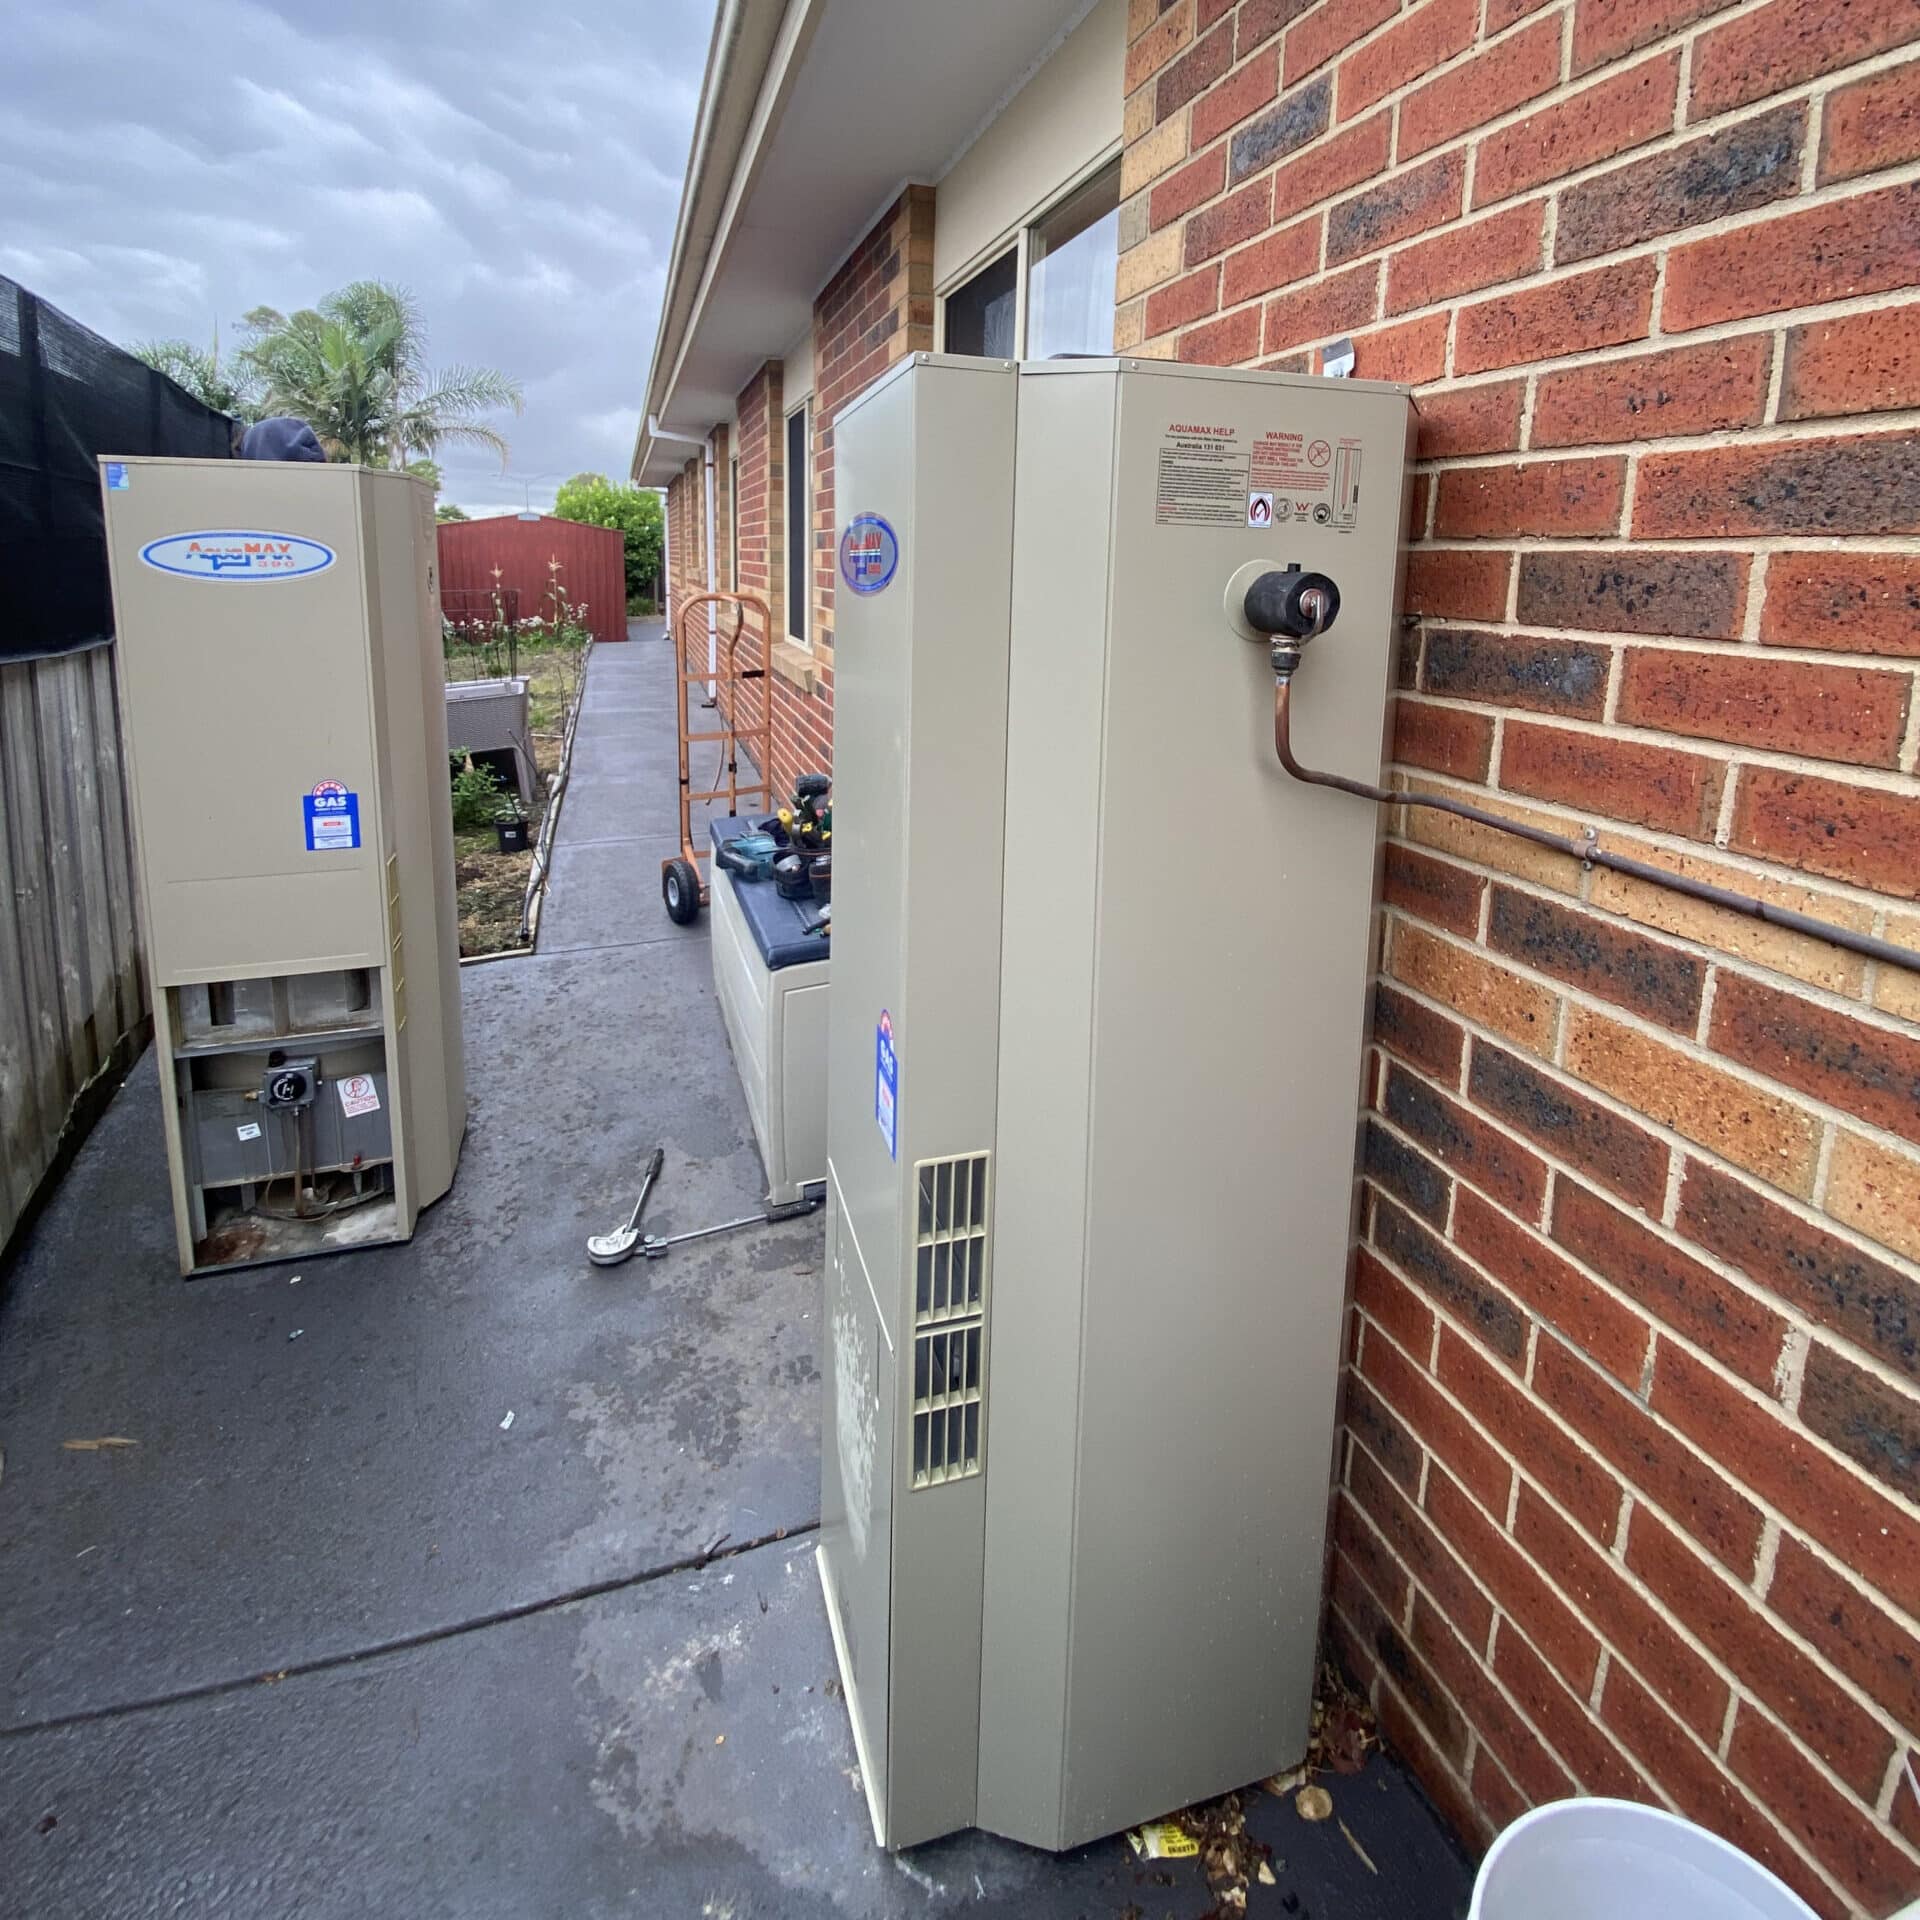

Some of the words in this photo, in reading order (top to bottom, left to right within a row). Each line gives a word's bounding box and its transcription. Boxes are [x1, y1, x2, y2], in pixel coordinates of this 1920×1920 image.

[1168, 424, 1212, 435] AQUAMAX
[1213, 427, 1235, 437] HELP
[1266, 431, 1304, 442] WARNING
[314, 796, 347, 808] GAS
